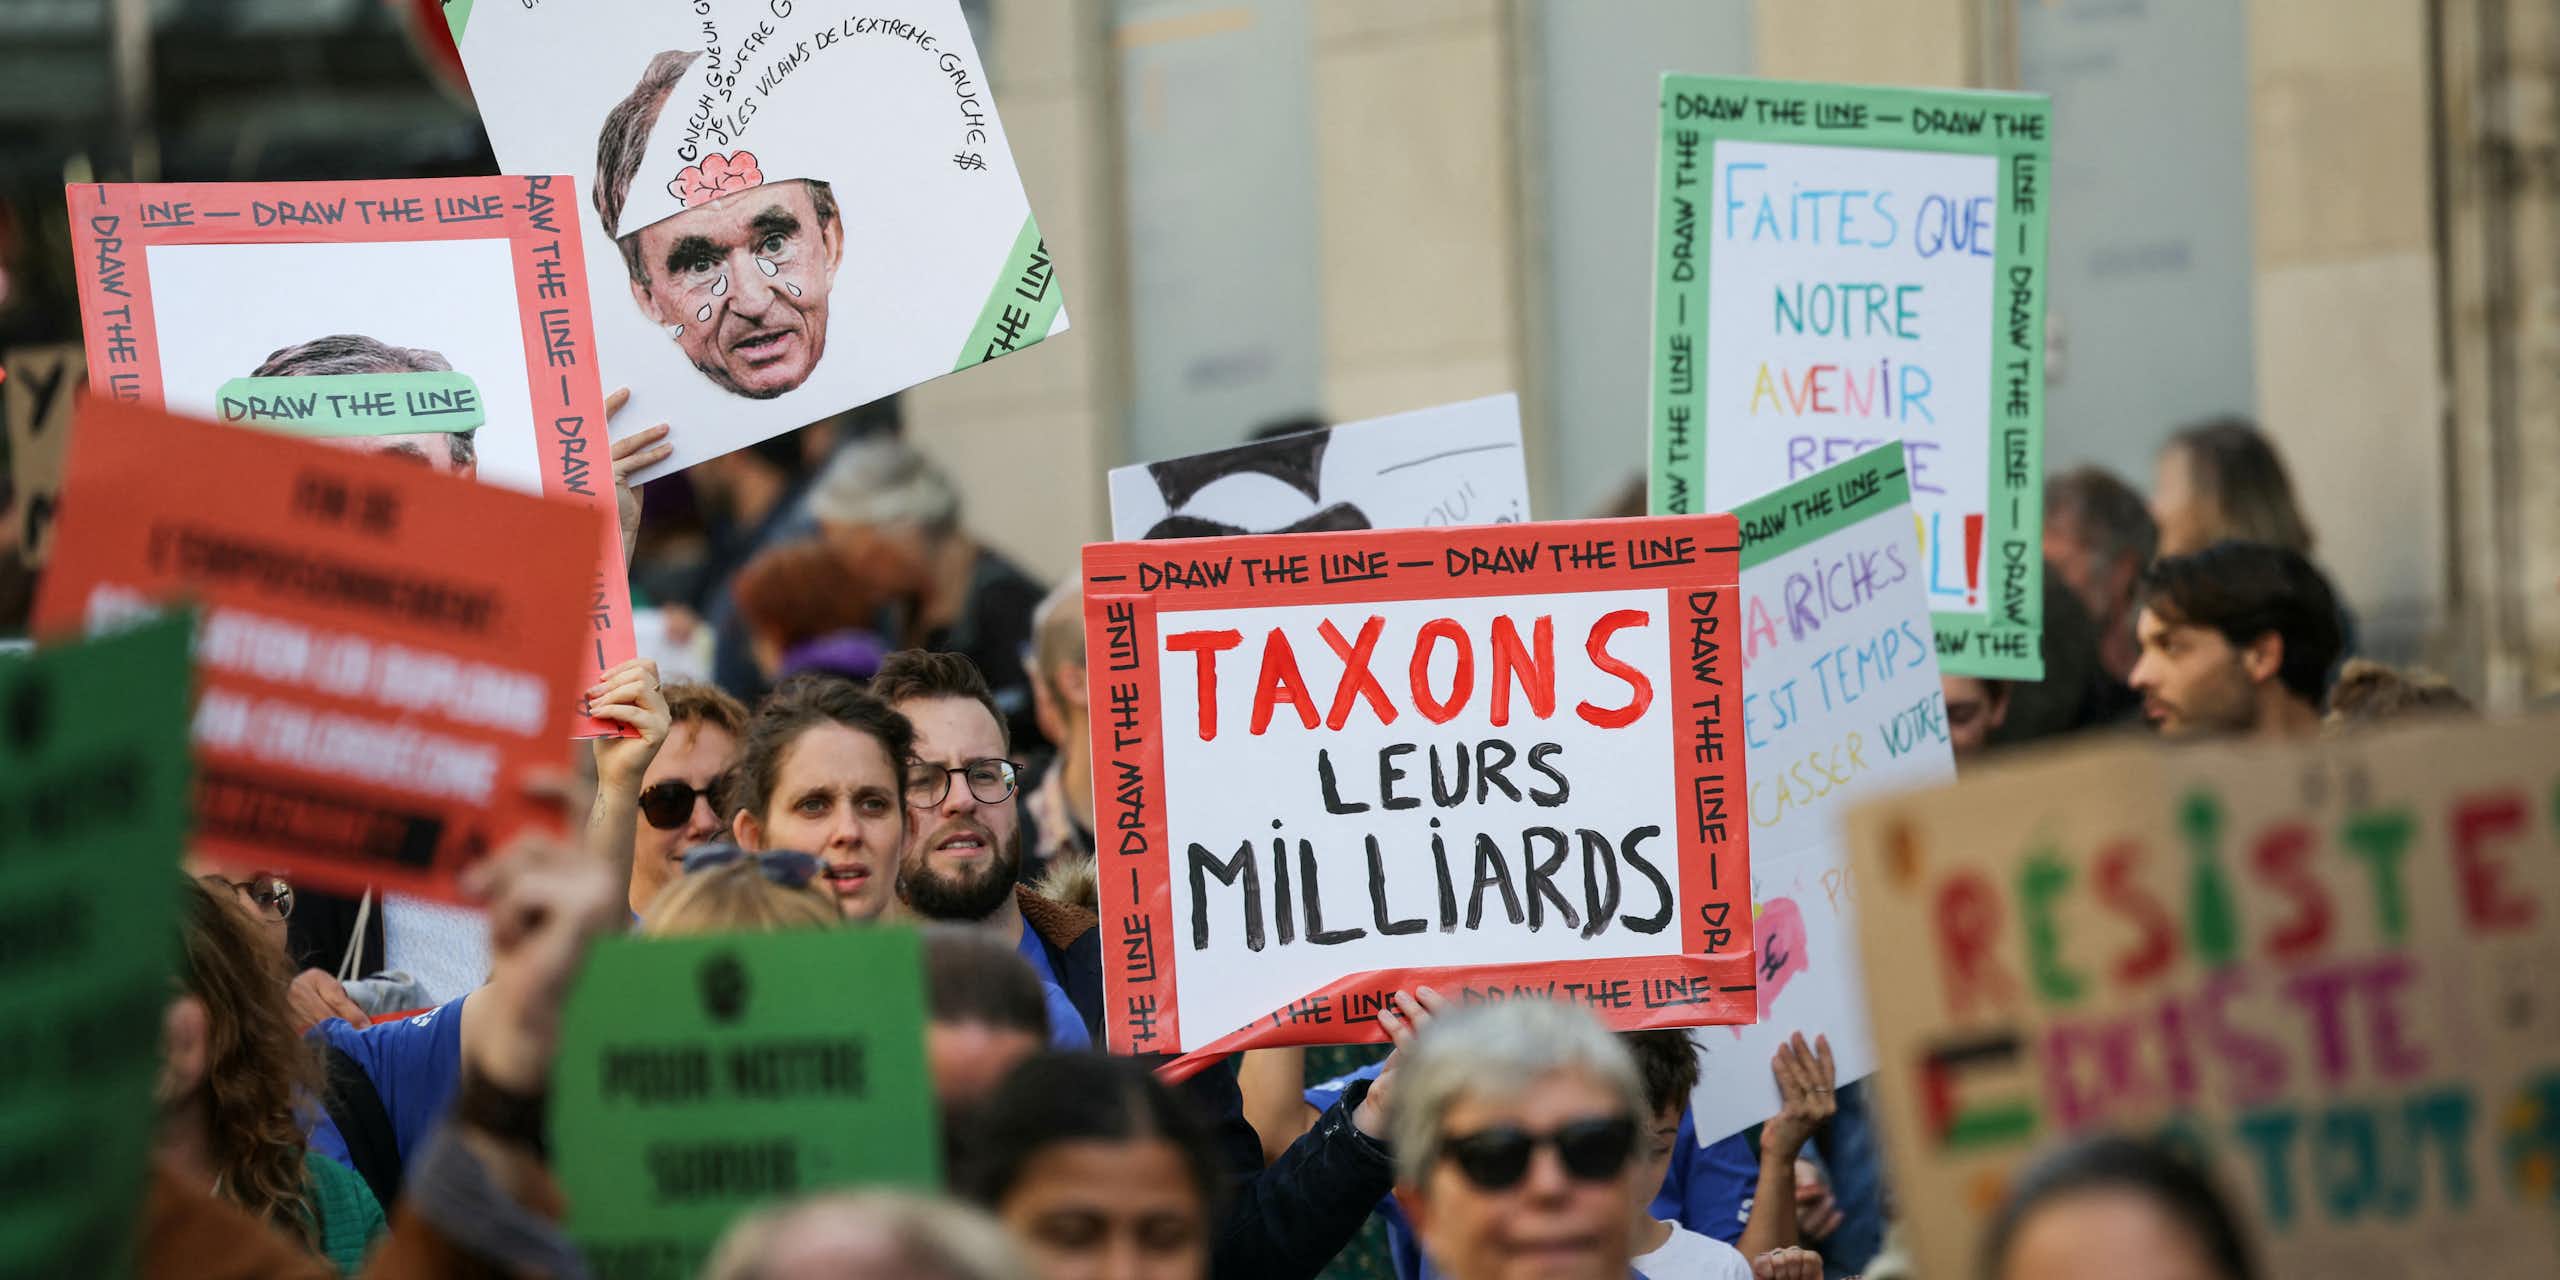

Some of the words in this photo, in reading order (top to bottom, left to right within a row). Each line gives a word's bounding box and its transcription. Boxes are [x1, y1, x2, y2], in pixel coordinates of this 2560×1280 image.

[678, 94, 715, 162] GNEUH
[703, 21, 723, 88] GNEUH
[705, 117, 728, 146] JE
[719, 20, 775, 103] SOUFFRE
[727, 97, 757, 137] LES
[814, 27, 839, 50] DE
[1674, 92, 1749, 121] DRAW
[1756, 98, 1805, 126] THE
[1815, 102, 1869, 130] LINE
[1912, 106, 1988, 135] DRAW
[1992, 112, 2045, 141] THE
[1674, 129, 1700, 190] THE
[2012, 153, 2037, 215] LINE
[252, 198, 347, 227] DRAW
[355, 197, 424, 225] THE
[435, 194, 504, 224] LINE
[1671, 197, 1695, 283] DRAW
[1913, 194, 1995, 259] QUE
[90, 215, 132, 298] DRAW
[532, 240, 568, 300] THE
[102, 304, 137, 364] THE
[540, 308, 577, 368] LINE
[1773, 281, 1924, 341] NOTRE
[2008, 265, 2034, 352] DRAW
[1668, 333, 1693, 396] LINE
[2006, 360, 2031, 419] THE
[221, 393, 318, 423] DRAW
[326, 391, 397, 419] THE
[406, 388, 477, 417] LINE
[1667, 406, 1692, 466] THE
[554, 416, 597, 497] DRAW
[2004, 428, 2028, 489] LINE
[1791, 488, 1833, 526] THE
[1838, 469, 1882, 509] LINE
[1138, 556, 1233, 592] DRAW
[1241, 554, 1309, 586] THE
[1320, 550, 1389, 584] LINE
[1445, 541, 1540, 577] DRAW
[1548, 540, 1617, 572] THE
[1626, 536, 1697, 570] LINE
[2002, 540, 2031, 627] DRAW
[1106, 601, 1140, 671] LINE
[1688, 591, 1724, 687] DRAW
[1810, 618, 1928, 713] TEMPS
[1977, 630, 2030, 660] THE
[1165, 608, 1654, 742] TAXONS
[1110, 682, 1142, 752] THE
[1692, 694, 1725, 763] THE
[1317, 738, 1570, 815] LEURS
[1749, 730, 1871, 828] CASSER
[1879, 690, 1949, 759] VOTRE
[1111, 759, 1149, 856] DRAW
[1694, 774, 1728, 845] LINE
[1123, 913, 1157, 983] LINE
[1563, 979, 1633, 1009] THE
[1641, 975, 1712, 1009] LINE
